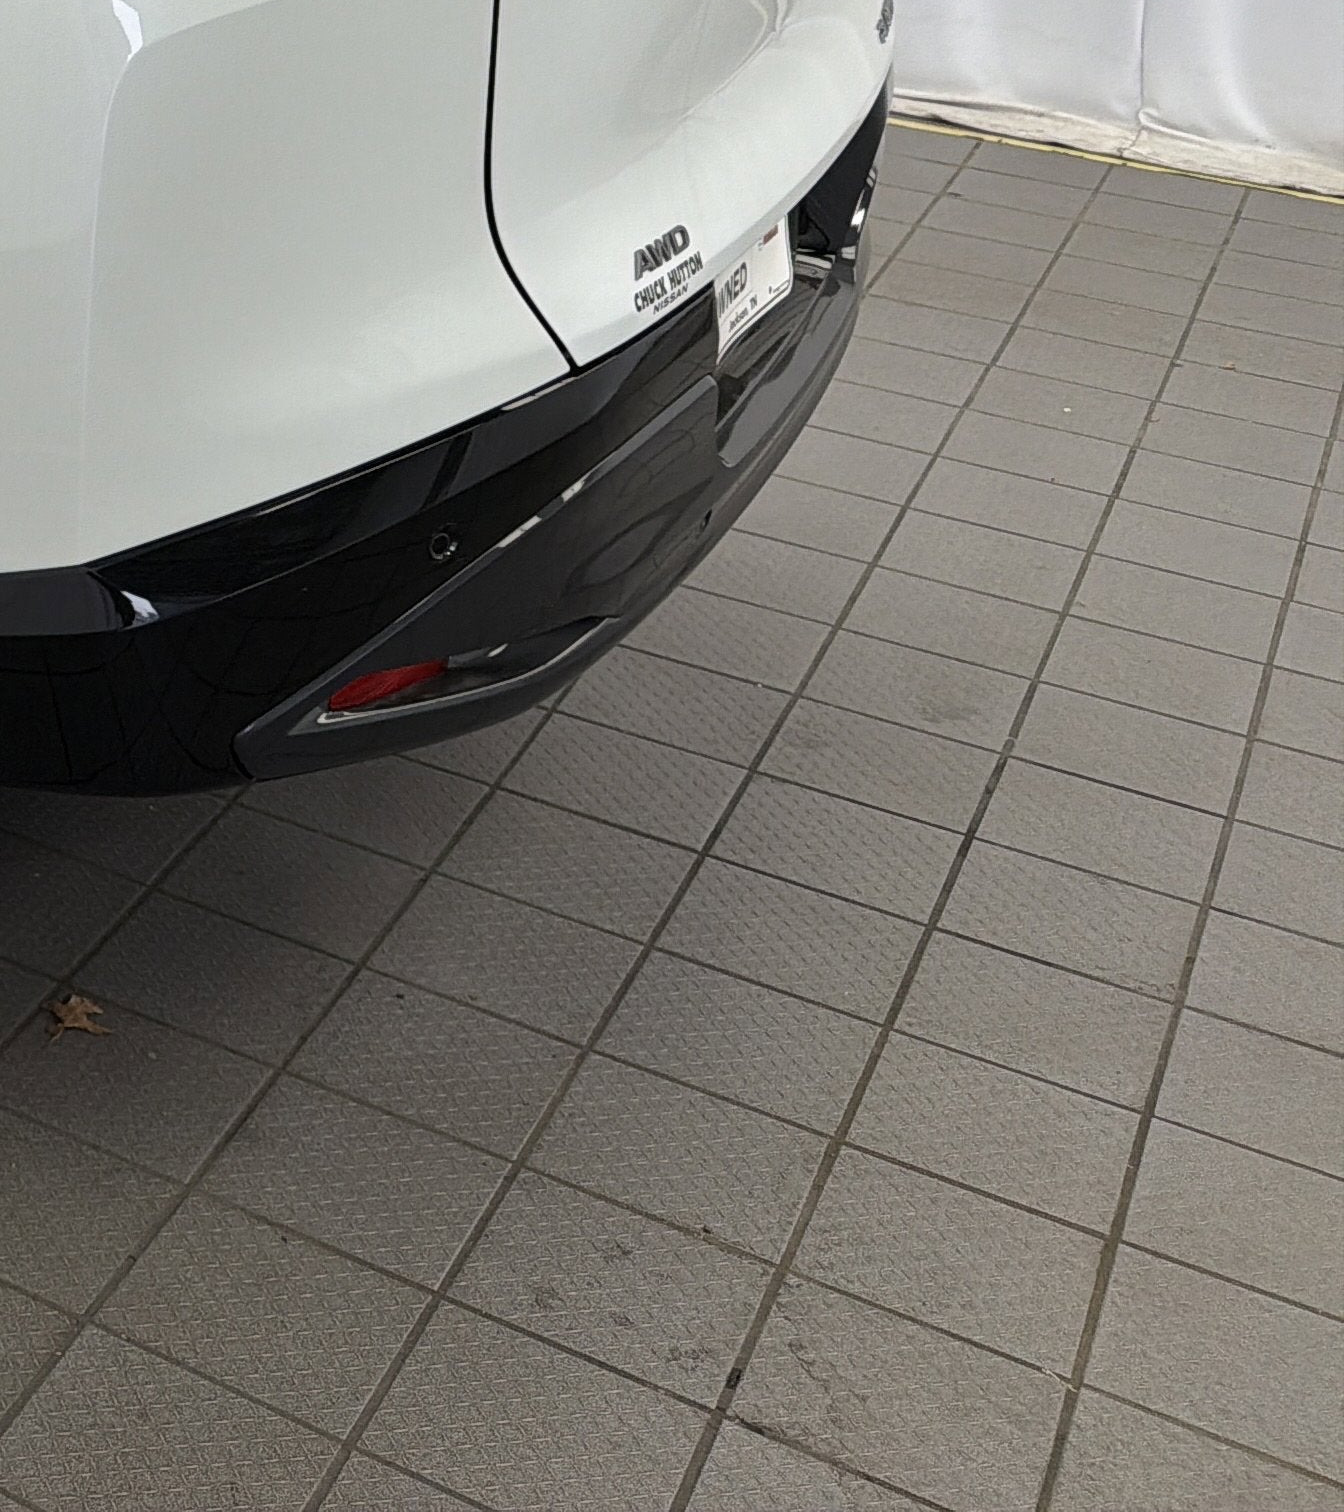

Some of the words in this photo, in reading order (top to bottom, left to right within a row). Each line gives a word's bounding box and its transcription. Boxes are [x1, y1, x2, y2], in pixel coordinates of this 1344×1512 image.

[633, 224, 691, 282] AWD
[634, 275, 668, 313] CHUCK
[666, 250, 704, 292] HUTTON
[652, 282, 689, 315] NISSAN
